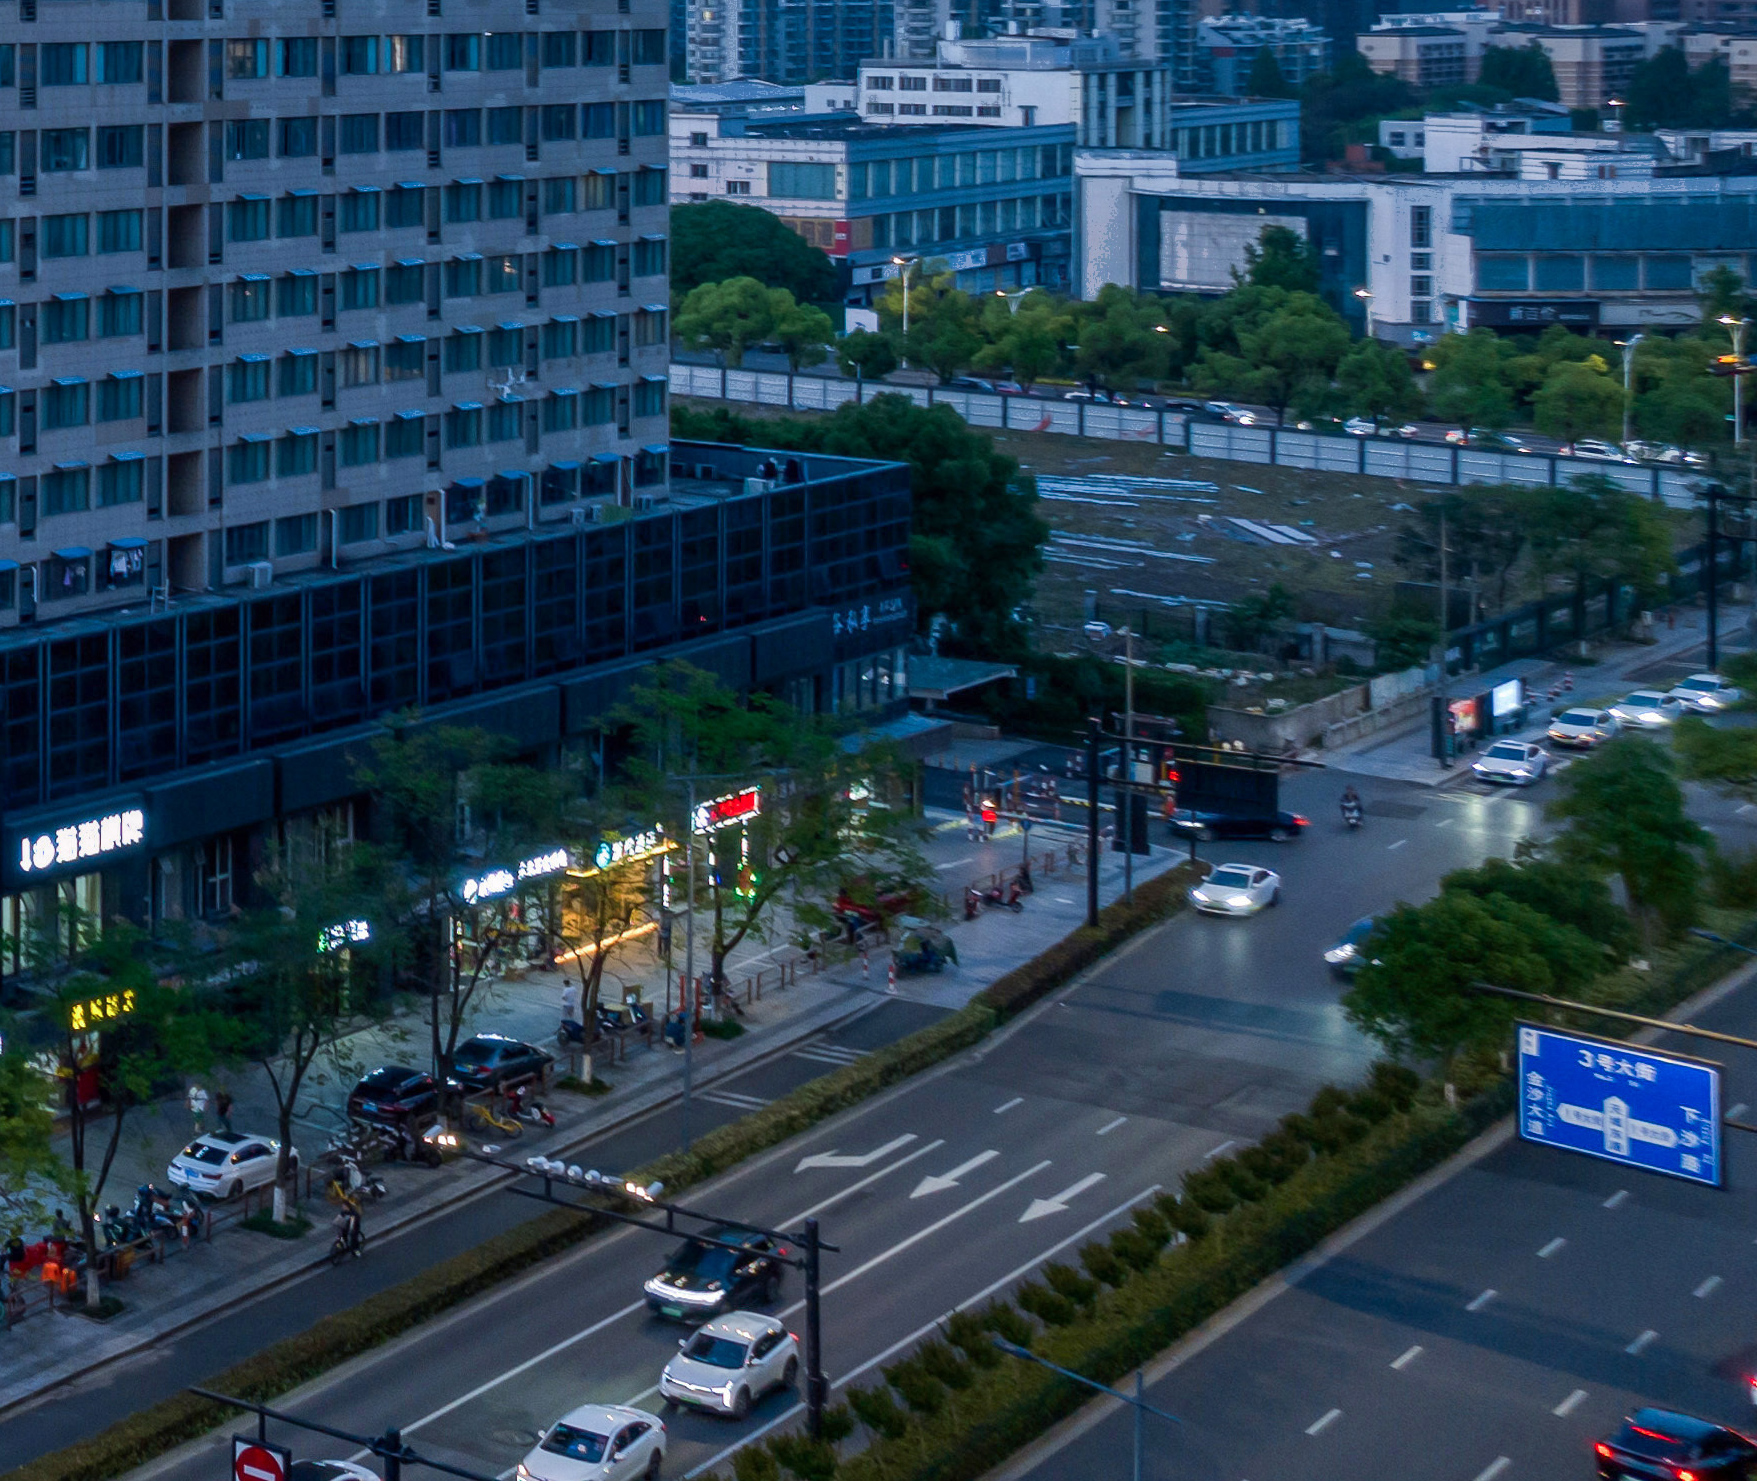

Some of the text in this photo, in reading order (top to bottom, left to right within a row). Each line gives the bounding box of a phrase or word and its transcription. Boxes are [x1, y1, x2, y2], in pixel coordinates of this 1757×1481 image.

[1578, 1049, 1657, 1083] 3号大街
[1526, 1071, 1545, 1136] 金沙大道
